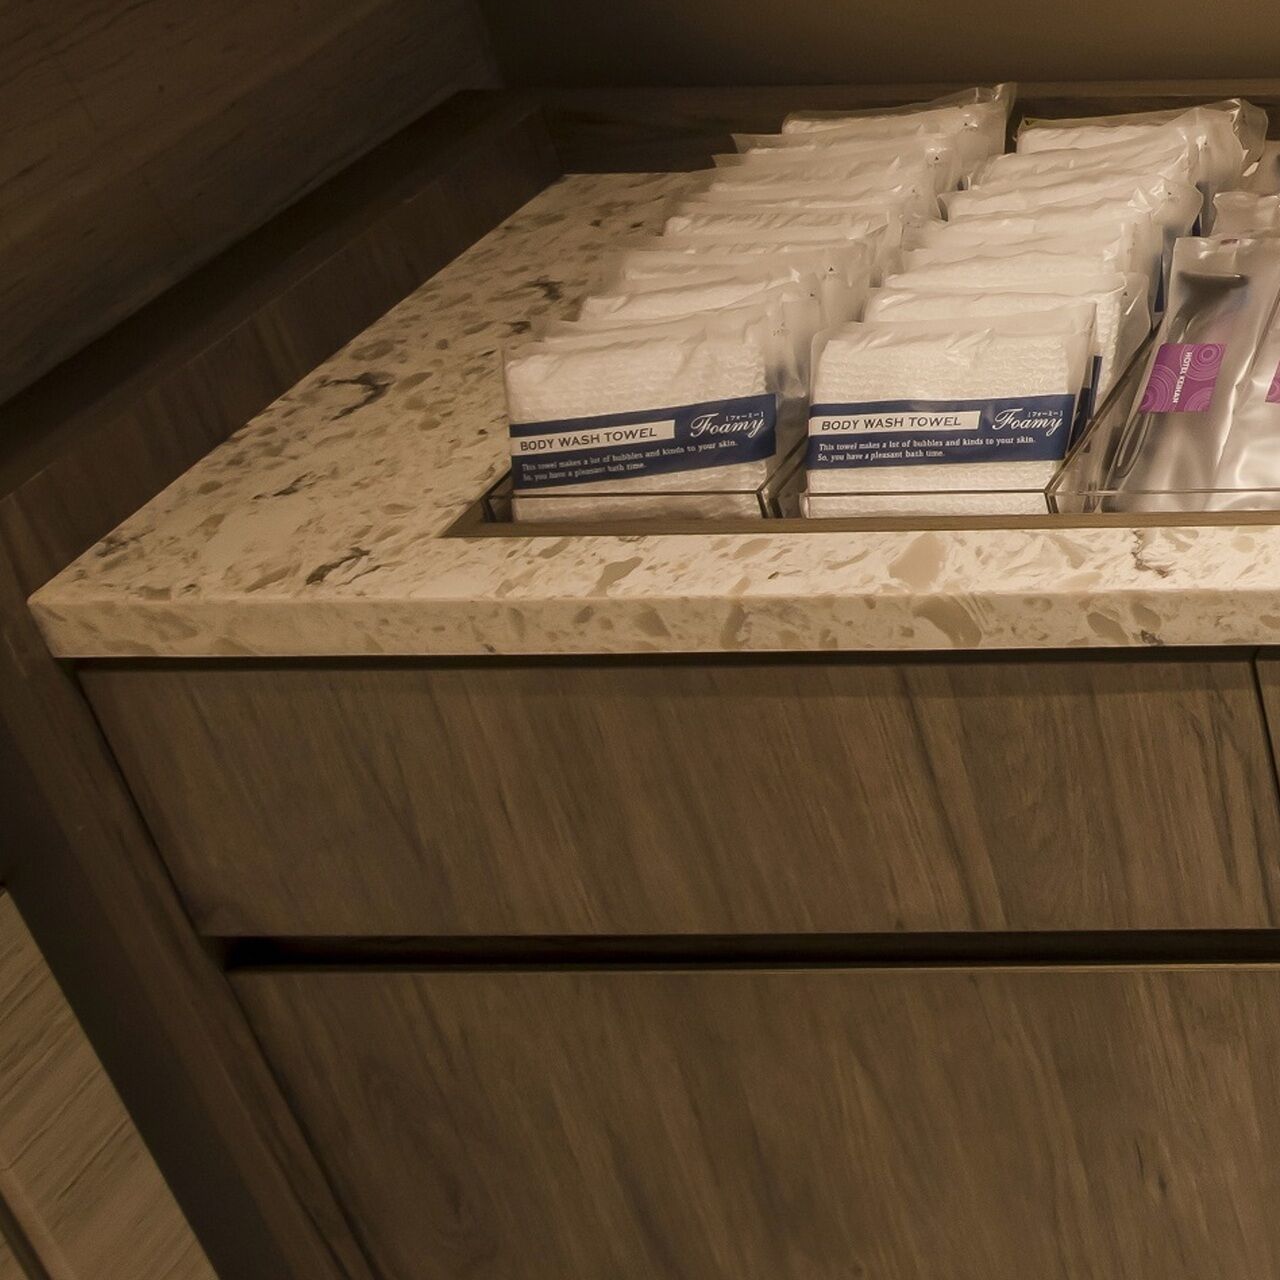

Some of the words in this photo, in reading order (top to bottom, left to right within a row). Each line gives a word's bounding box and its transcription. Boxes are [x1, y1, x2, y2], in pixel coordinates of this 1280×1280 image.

[1180, 351, 1193, 374] HOTEL
[1172, 376, 1185, 403] KEIHAN
[690, 412, 765, 438] Foamy
[821, 420, 859, 430] BODY
[864, 417, 904, 429] WASH
[908, 416, 962, 427] TOWEL
[992, 408, 1063, 437] Foamy
[520, 439, 554, 451] BODY
[558, 435, 600, 448] WASH
[604, 428, 657, 442] TOWEL
[819, 443, 834, 451] This
[912, 439, 943, 447] bubbles
[945, 438, 960, 446] and
[962, 438, 984, 446] kinds
[996, 438, 1014, 447] your
[1016, 436, 1036, 444] skin.
[817, 453, 829, 461] So,
[870, 451, 903, 461] pleasant
[905, 449, 924, 458] bath
